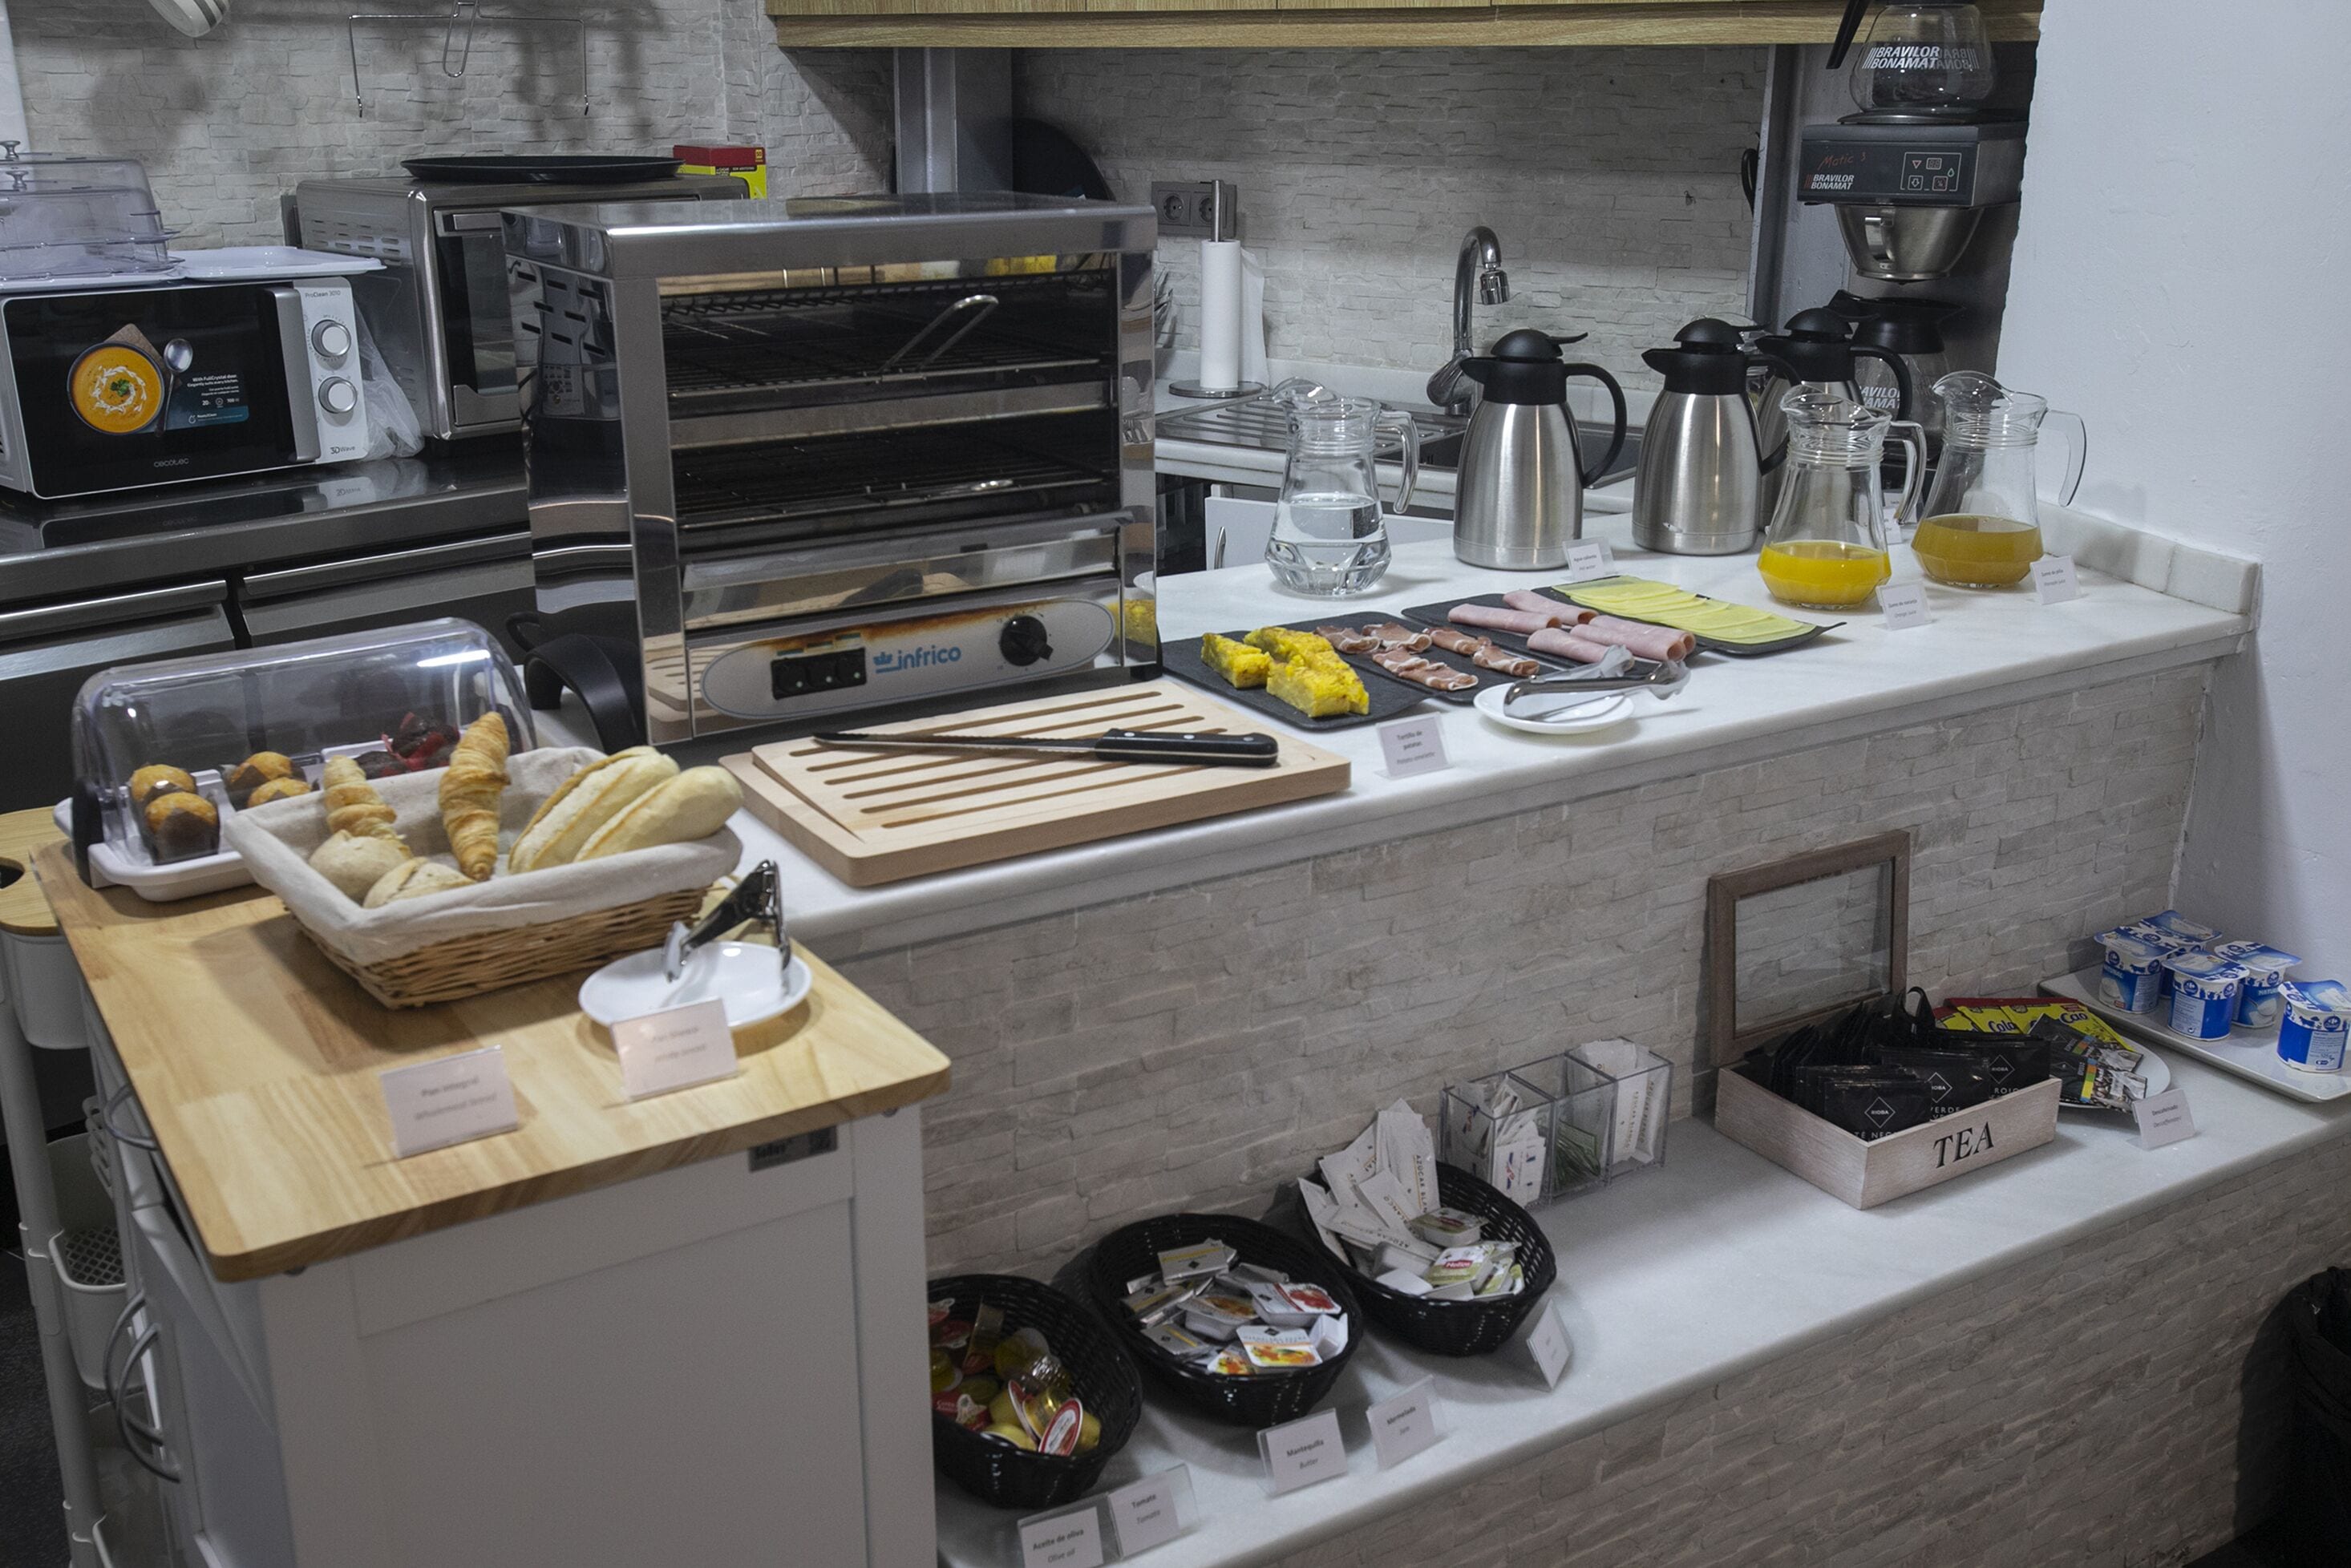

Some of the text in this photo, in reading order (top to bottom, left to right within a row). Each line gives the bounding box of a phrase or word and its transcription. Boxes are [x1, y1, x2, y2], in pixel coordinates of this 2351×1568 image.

[1876, 46, 1940, 57] BRAVILOR
[1871, 57, 1938, 68] BONAMAT
[1817, 153, 1854, 171] Matic
[1813, 174, 1855, 182] BRAVILOR
[1859, 386, 1900, 398] AVILO
[897, 645, 961, 670] infrico
[2061, 1012, 2088, 1024] Cao
[1989, 1020, 2016, 1033] Cola
[1933, 1121, 1994, 1169] TEA
[1286, 1439, 1325, 1457] Mantequilla
[1033, 1529, 1084, 1550] Aceite de oliva
